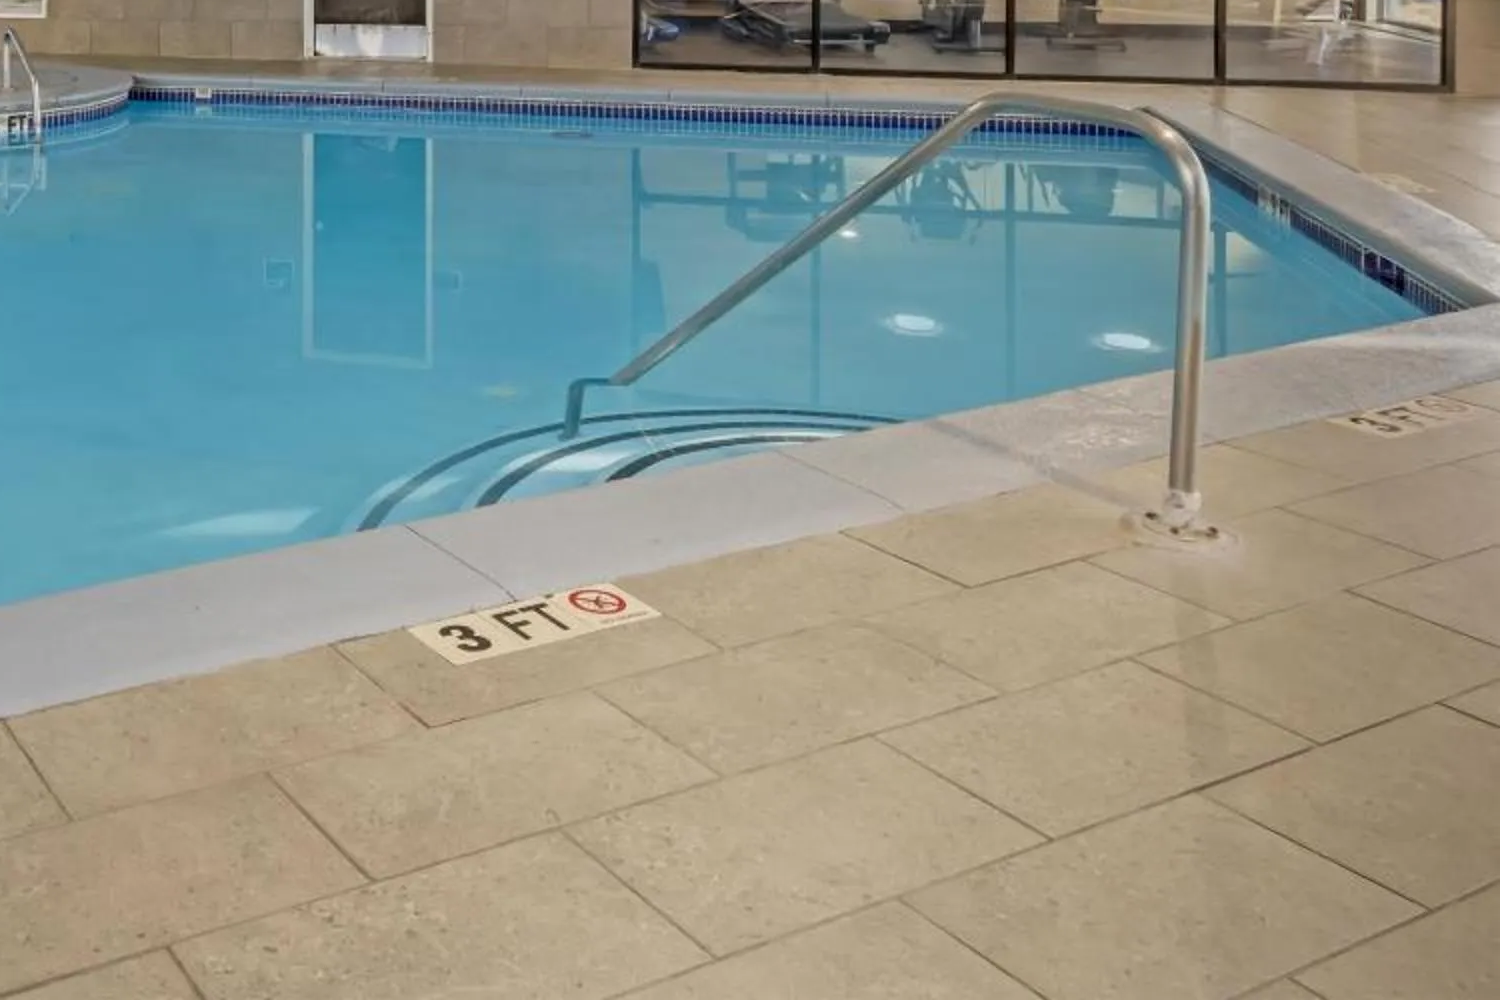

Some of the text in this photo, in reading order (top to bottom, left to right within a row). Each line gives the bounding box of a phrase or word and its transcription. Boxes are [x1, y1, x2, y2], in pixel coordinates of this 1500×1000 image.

[7, 114, 27, 133] FT
[439, 602, 570, 652] 3 FT
